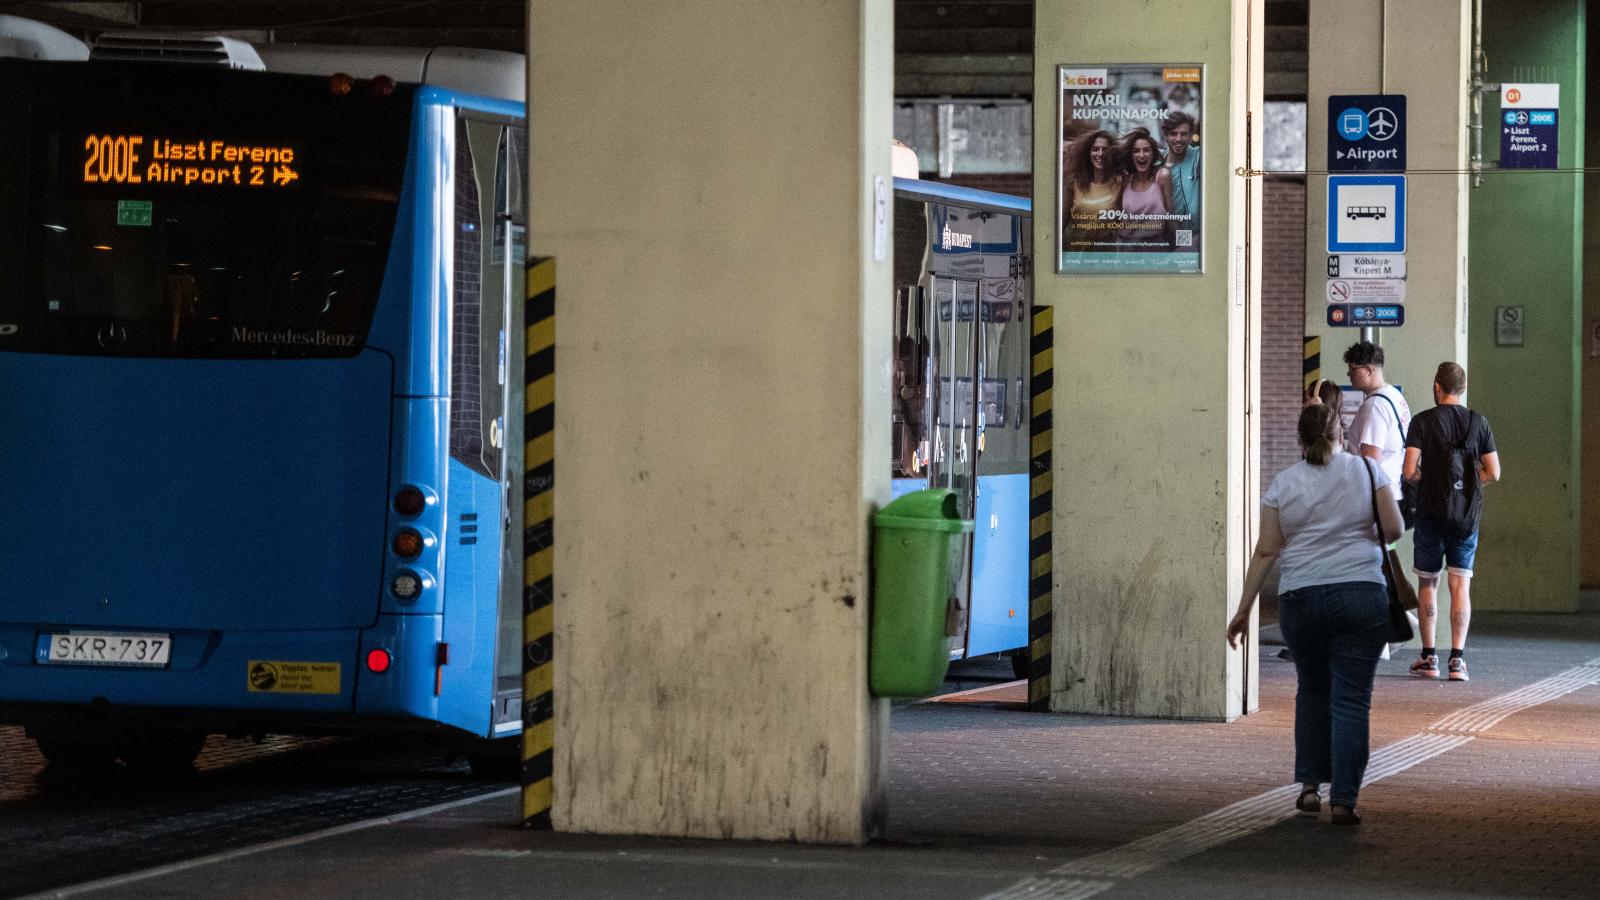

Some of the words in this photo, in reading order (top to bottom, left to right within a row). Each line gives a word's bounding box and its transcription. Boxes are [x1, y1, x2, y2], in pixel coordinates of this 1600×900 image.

[1072, 91, 1120, 106] NYÁRI
[1072, 108, 1169, 120] KUPONNAPOK
[1532, 114, 1553, 122] 200E
[1511, 127, 1530, 135] Liszt
[153, 138, 206, 161] Liszt
[211, 140, 294, 164] Ferenc
[1510, 144, 1539, 152] Airport
[84, 134, 143, 184] 200E
[1346, 147, 1398, 162] Airport
[147, 162, 241, 186] Airport
[250, 166, 264, 185] 2
[1098, 209, 1129, 220] 20%
[1129, 212, 1192, 222] kedvezménnyel
[1329, 258, 1338, 266] M
[1329, 267, 1338, 275] M
[1354, 267, 1381, 275] Kispest
[1377, 309, 1398, 317] 200E
[40, 649, 47, 657] H
[56, 636, 164, 661] SKR-737
